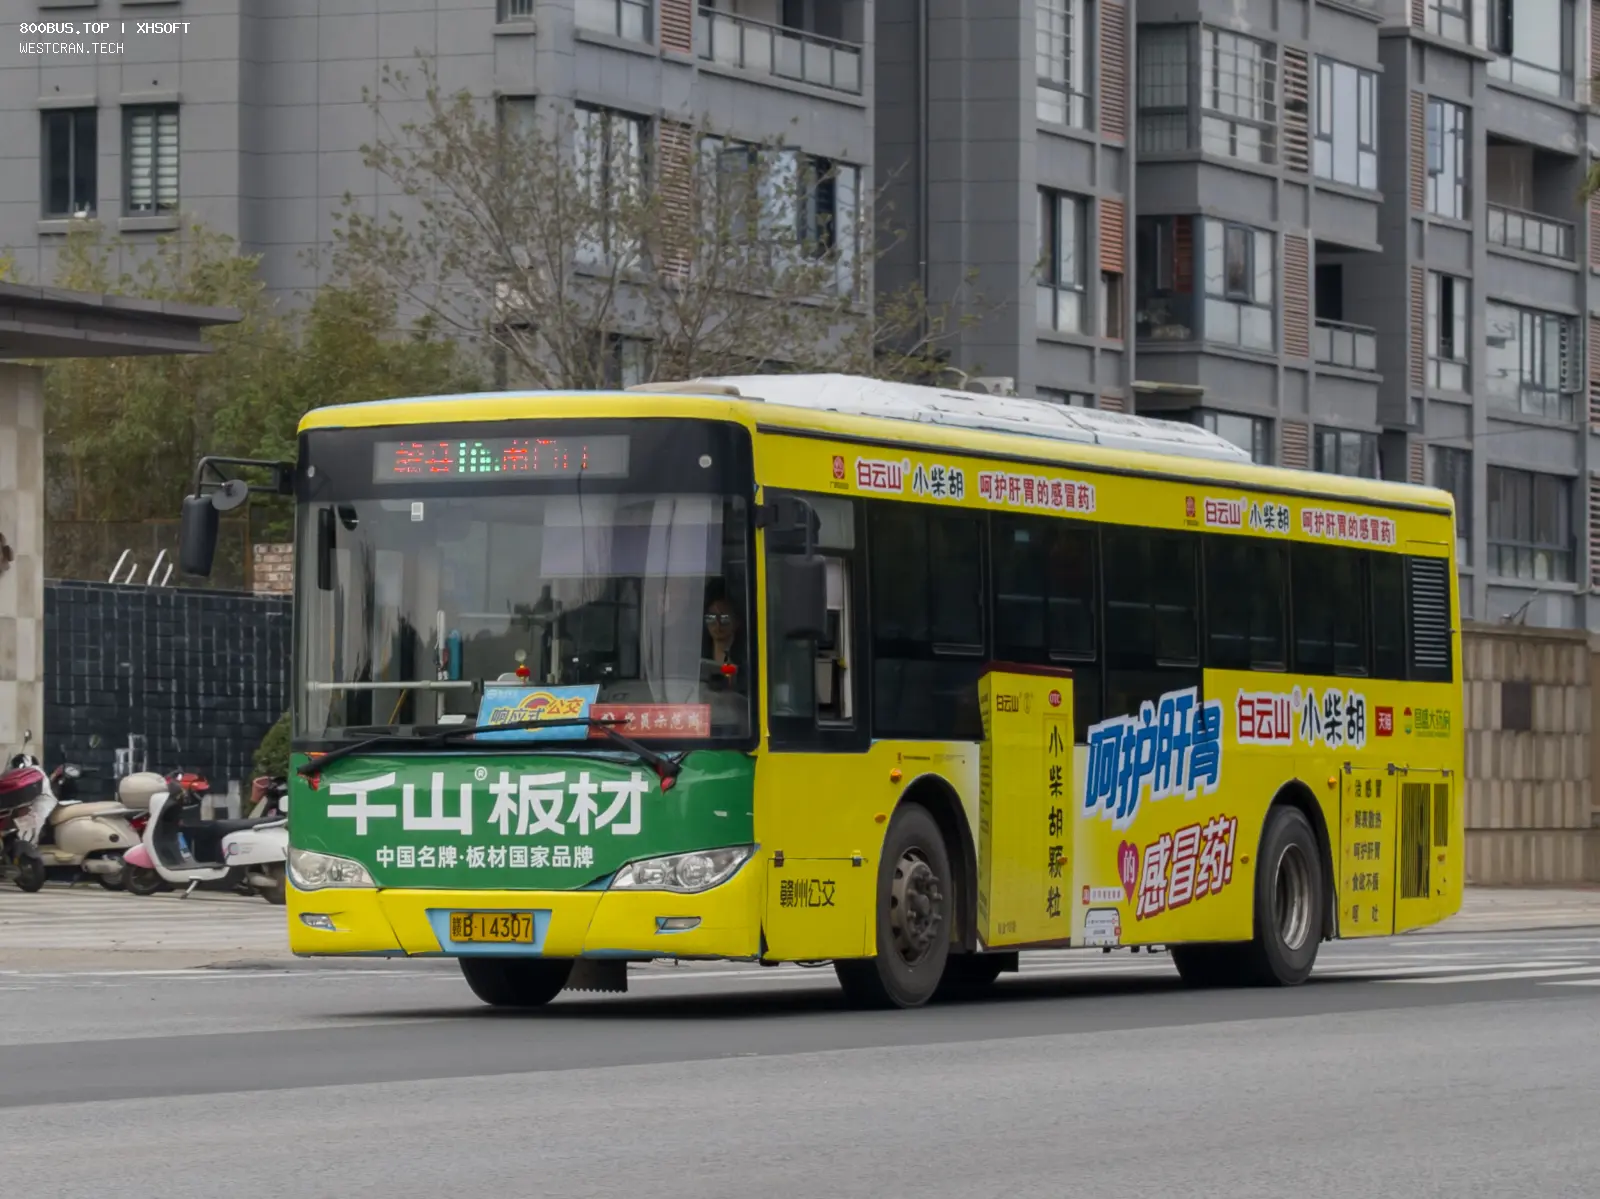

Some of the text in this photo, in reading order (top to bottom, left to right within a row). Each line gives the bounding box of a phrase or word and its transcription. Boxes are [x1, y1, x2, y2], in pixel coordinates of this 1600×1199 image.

[856, 460, 1096, 511] 白云山 小柴胡 呵护肝胃的感冒药!
[1204, 499, 1242, 526] 白云山
[1249, 503, 1290, 532] 小柴胡
[1238, 692, 1366, 745] 白云山 小柴胡
[1084, 693, 1221, 820] 呵护肝胃
[1046, 725, 1064, 918] 小柴胡颗粒
[779, 879, 836, 908] 赣州公交
